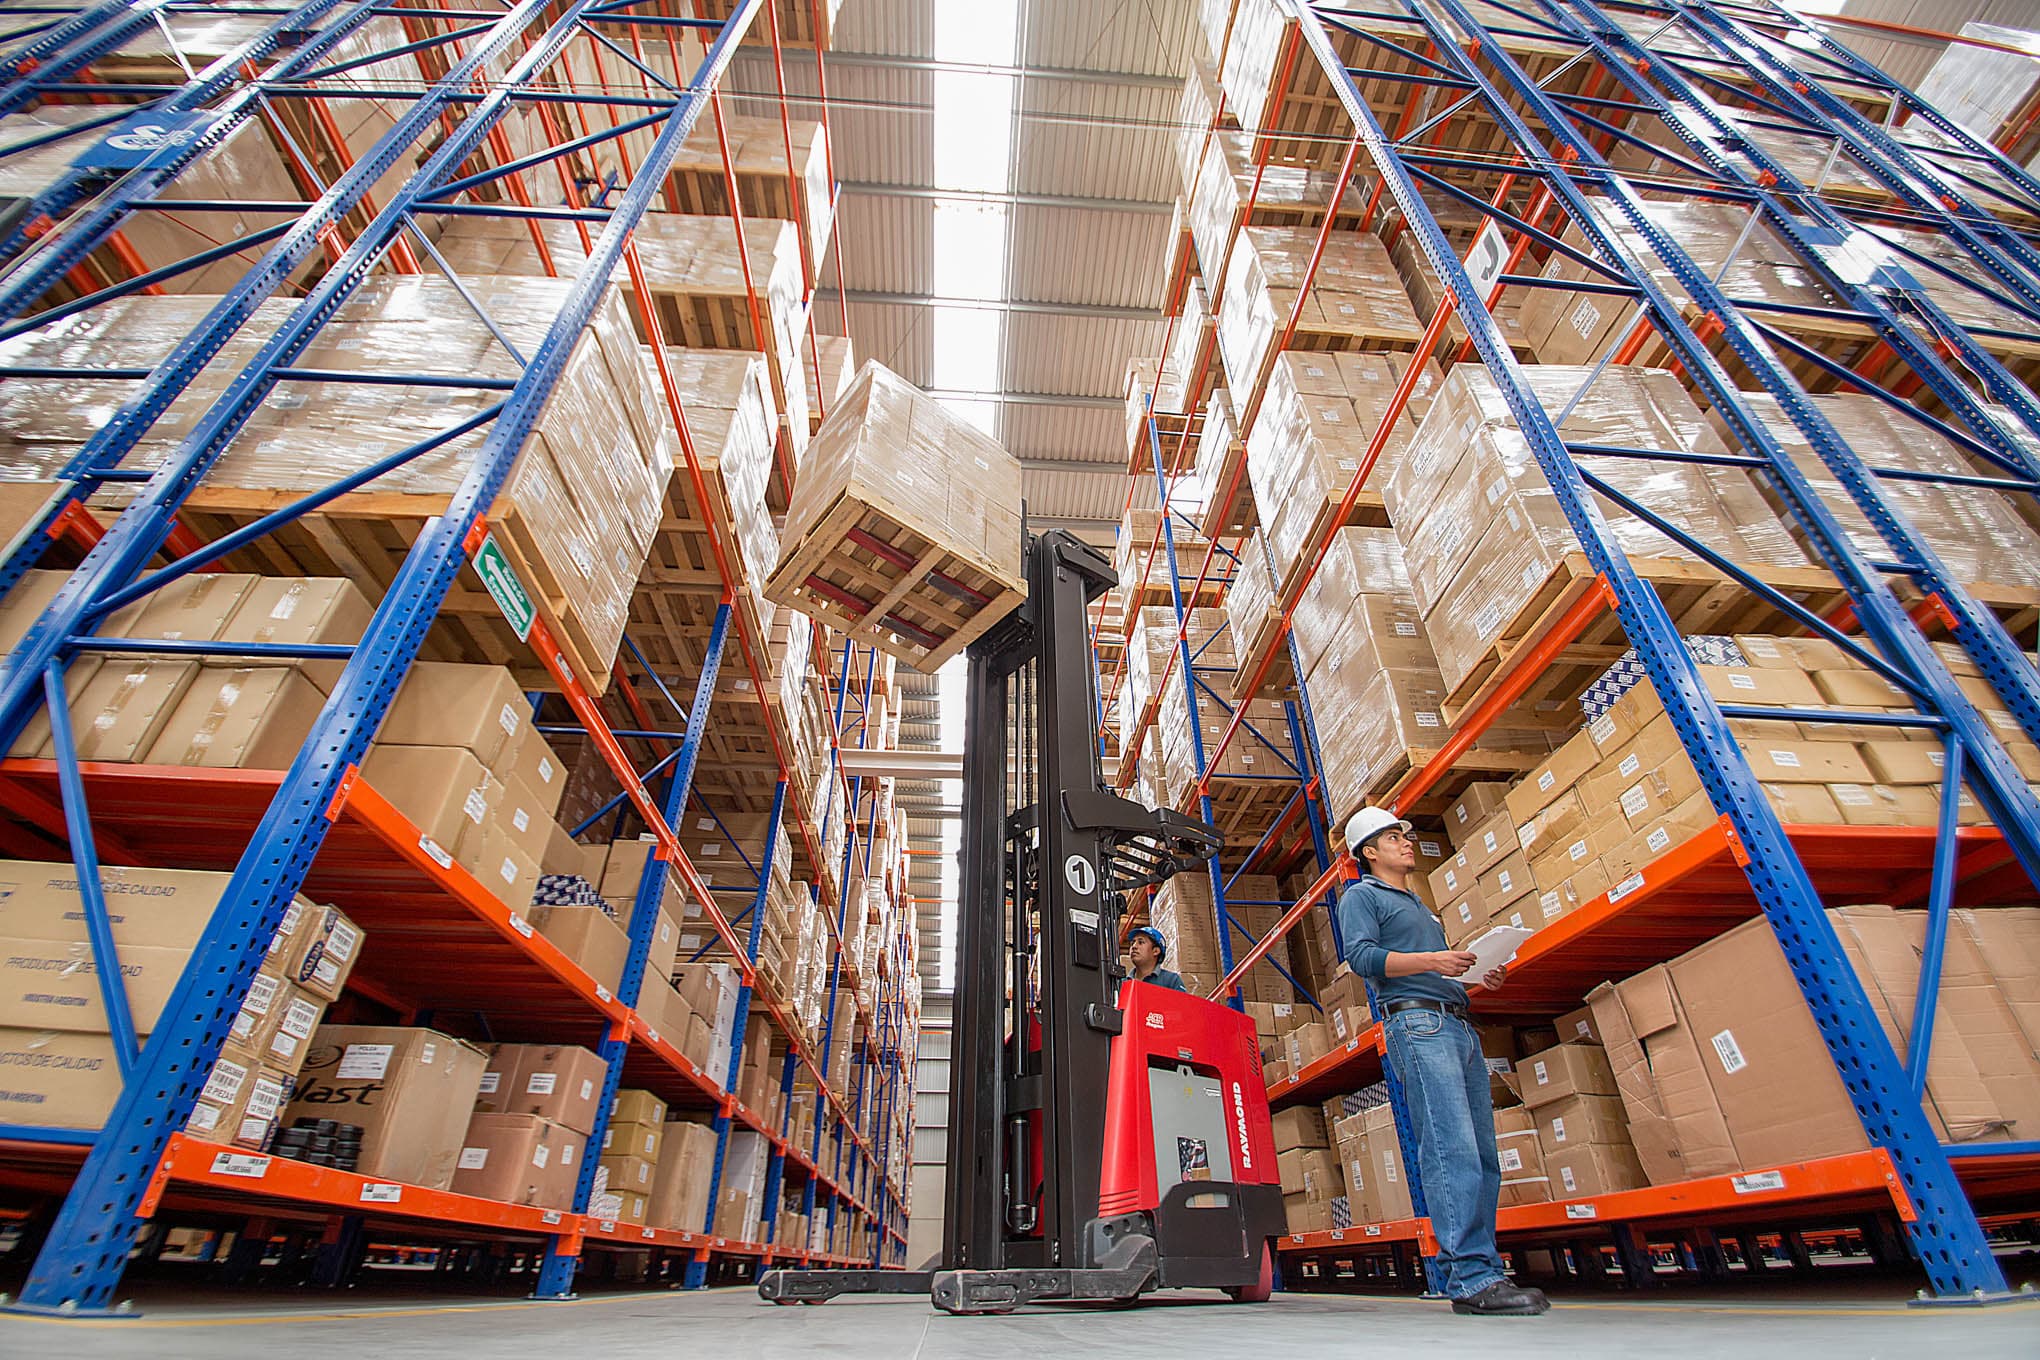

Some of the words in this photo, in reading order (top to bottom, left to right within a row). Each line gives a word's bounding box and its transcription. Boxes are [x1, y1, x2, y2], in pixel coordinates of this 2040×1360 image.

[1071, 860, 1086, 890] 1
[129, 884, 177, 897] CALIDAD
[51, 1056, 104, 1071] CALIDAD
[291, 1078, 385, 1105] last
[1232, 1081, 1252, 1169] RAYMOND
